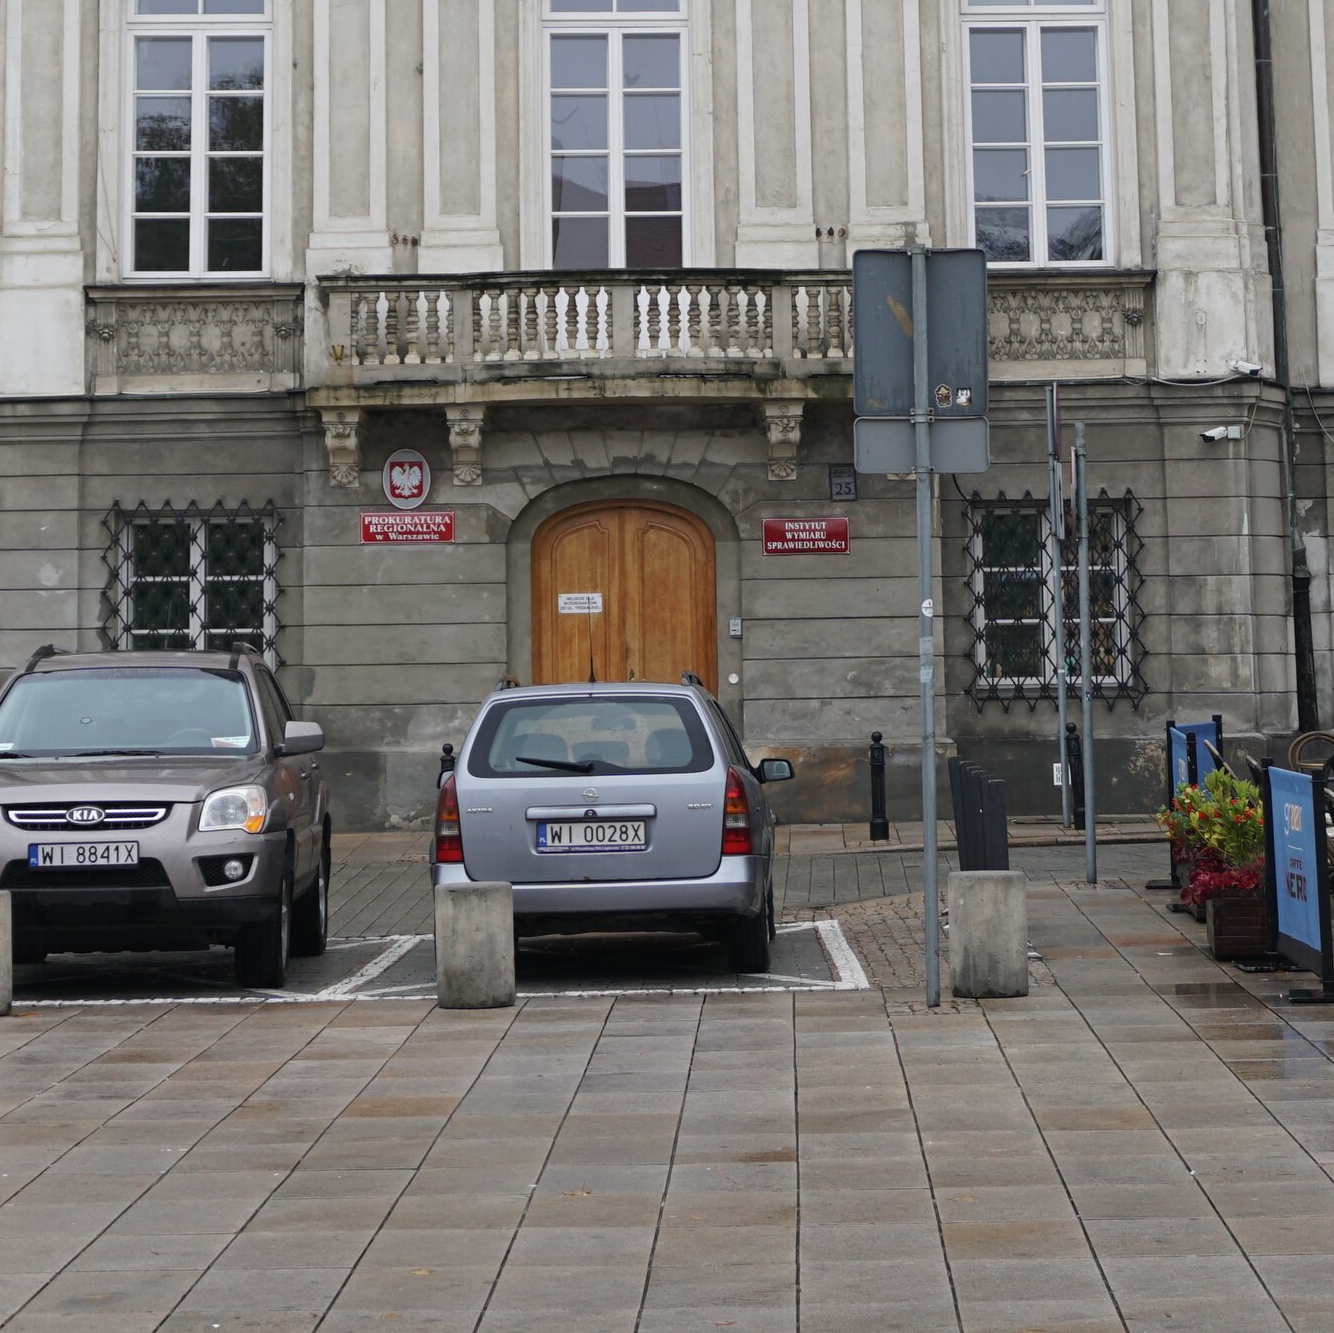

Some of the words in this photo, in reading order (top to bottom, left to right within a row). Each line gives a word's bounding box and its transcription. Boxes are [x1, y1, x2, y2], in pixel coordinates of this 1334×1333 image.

[835, 482, 852, 496] 25
[364, 516, 451, 525] PROKURATURA
[369, 524, 446, 533] REGIONALNA
[785, 522, 827, 530] INSTYTUT
[388, 532, 439, 540] Warszawie
[785, 531, 827, 539] WYMIARU
[767, 539, 845, 549] SPRAWIEDLIWOŚCI
[73, 810, 99, 820] KIA
[550, 825, 573, 844] WI
[584, 823, 643, 843] 0028X
[42, 846, 64, 865] WI
[76, 845, 135, 864] 8841X
